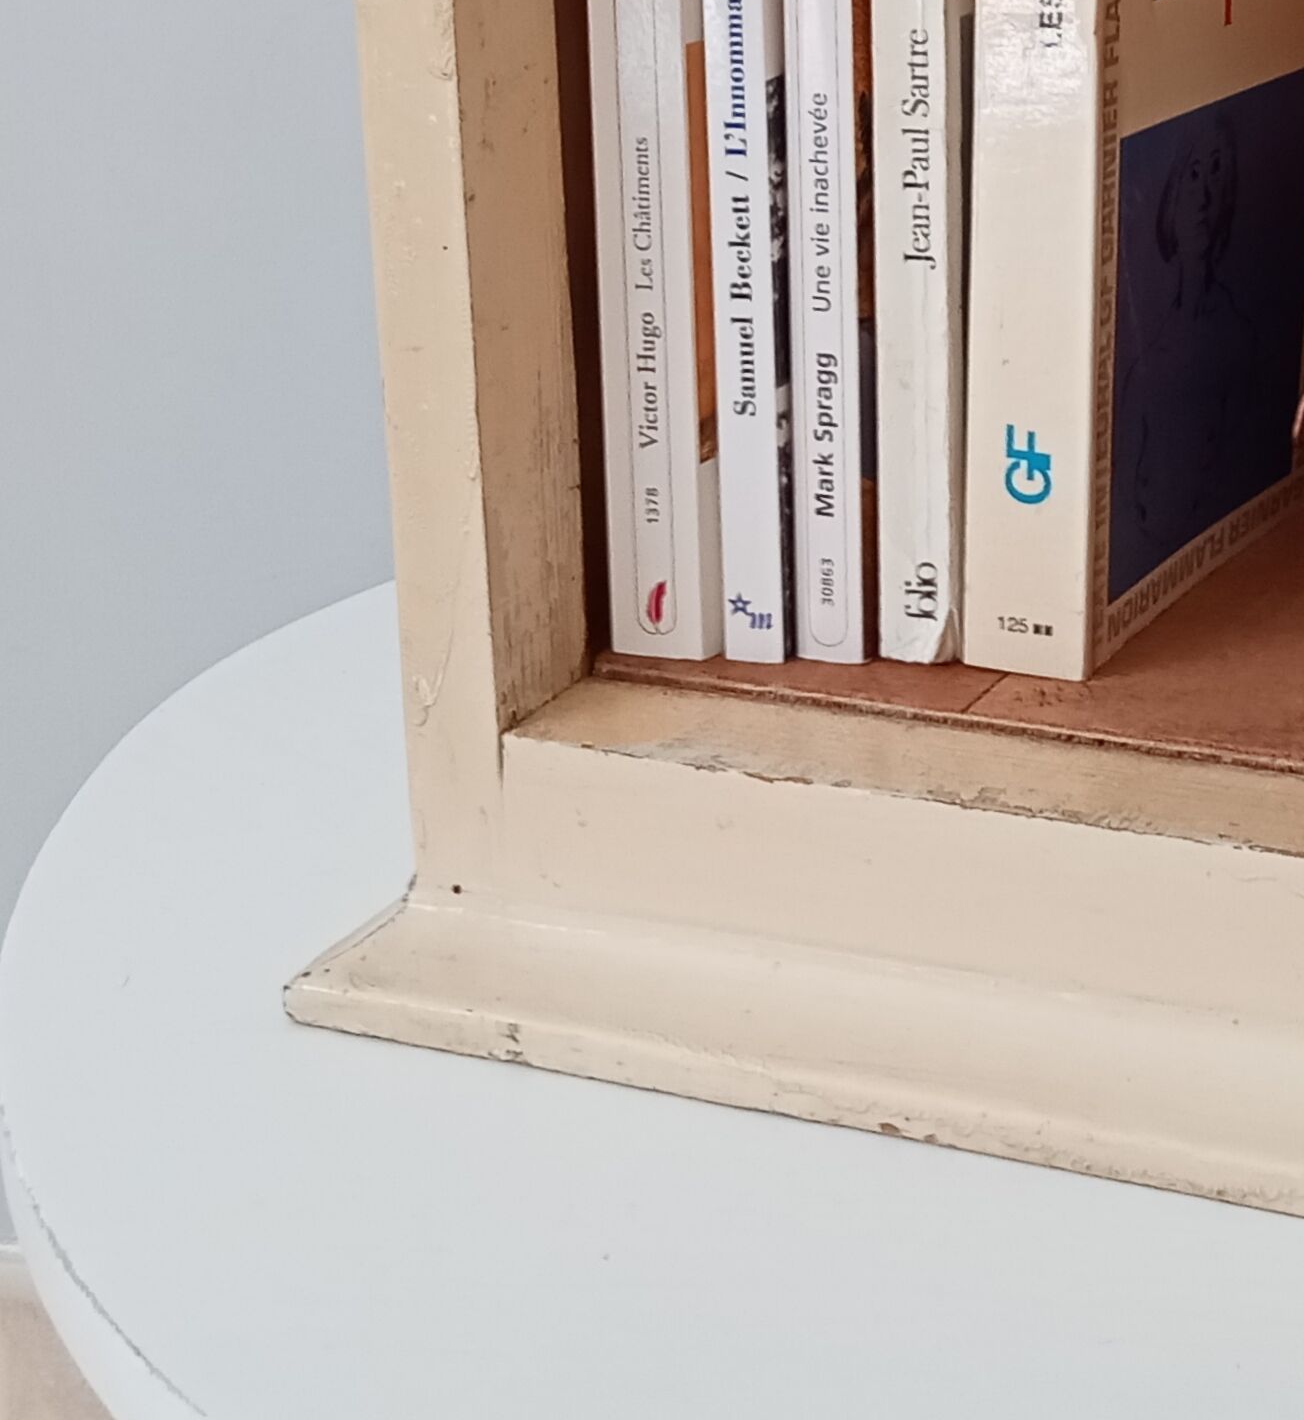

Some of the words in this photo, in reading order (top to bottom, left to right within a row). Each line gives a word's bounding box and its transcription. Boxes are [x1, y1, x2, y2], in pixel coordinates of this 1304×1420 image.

[901, 29, 930, 117] Sartre
[807, 92, 830, 213] inachevée
[1101, 80, 1119, 265] GARNIER
[632, 137, 652, 251] Châtiments
[901, 127, 936, 270] Jean-Paul
[635, 258, 654, 291] Les
[728, 195, 753, 302] Beckett
[810, 222, 831, 257] vie
[812, 265, 832, 312] Une
[637, 311, 663, 375] Hugo
[733, 316, 757, 417] Samuel
[639, 381, 660, 450] Victor
[815, 351, 839, 443] Spragg
[813, 450, 836, 518] Mark
[1005, 424, 1052, 505] GF
[645, 487, 660, 524] 1378
[905, 560, 939, 622] folio
[998, 616, 1029, 633] 125
[1107, 528, 1224, 642] FLAMMARION
